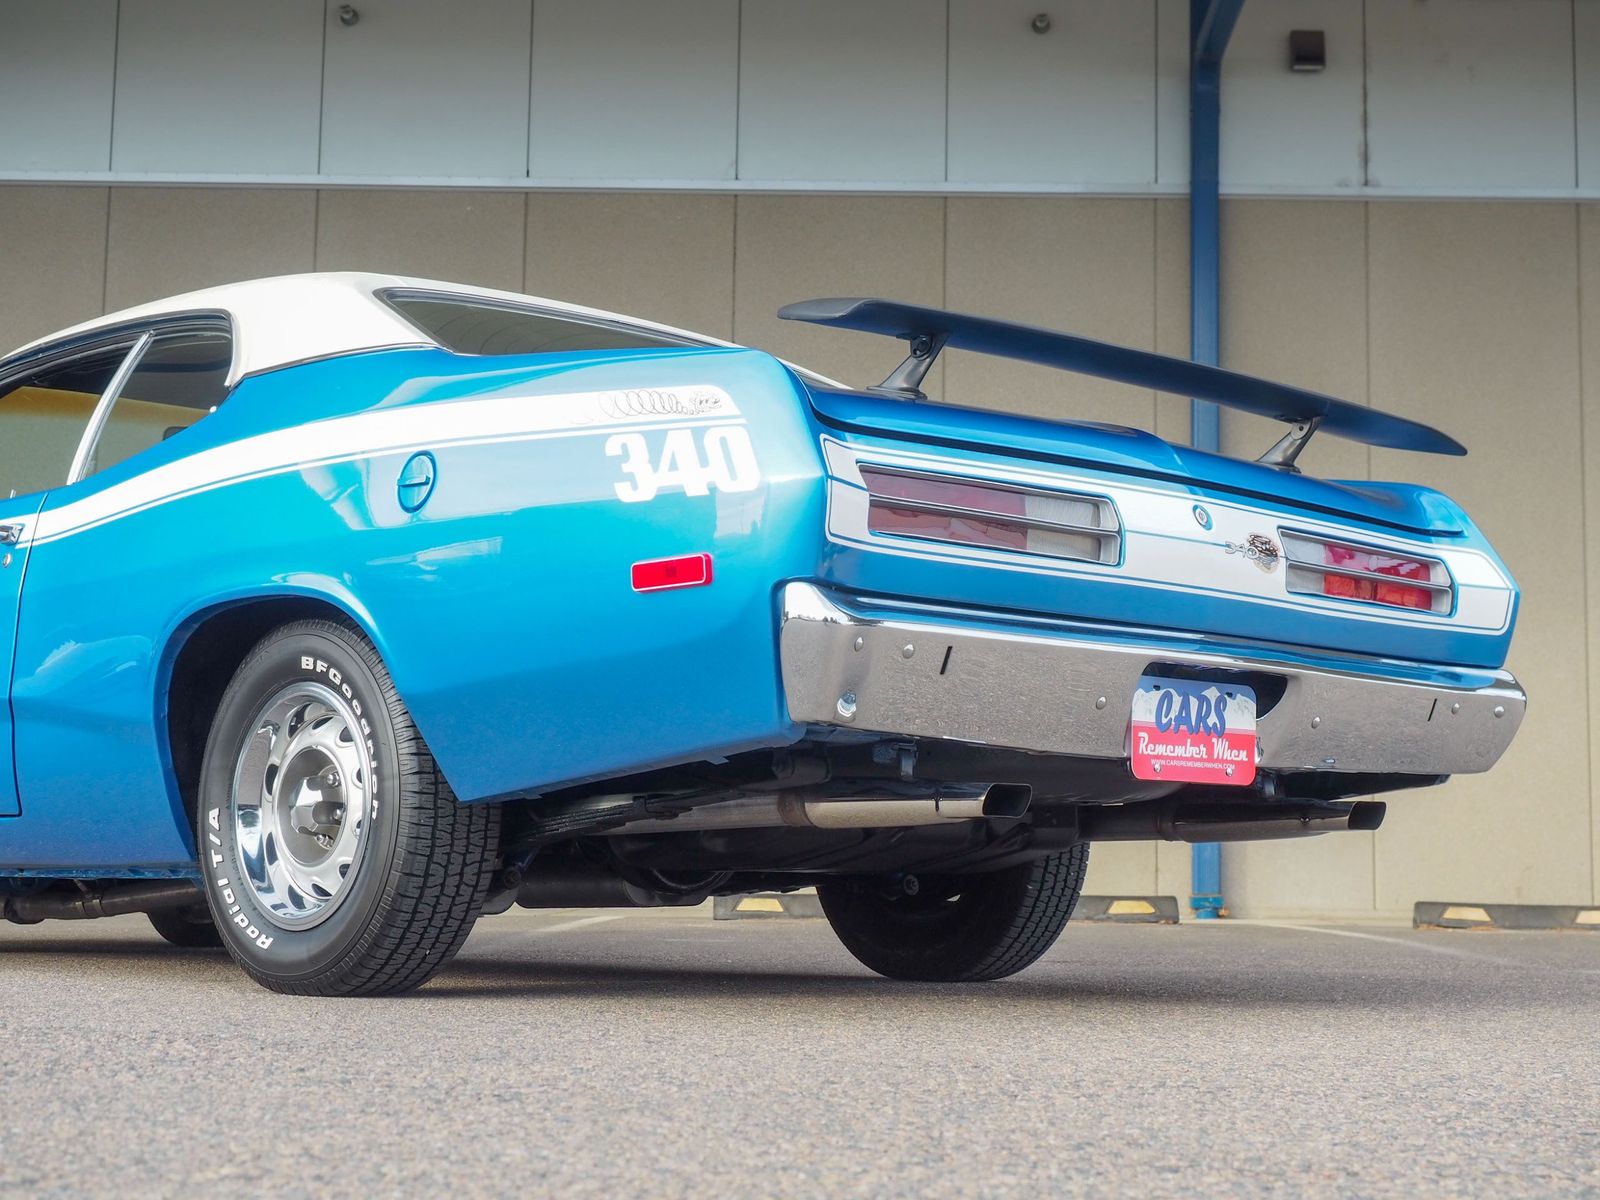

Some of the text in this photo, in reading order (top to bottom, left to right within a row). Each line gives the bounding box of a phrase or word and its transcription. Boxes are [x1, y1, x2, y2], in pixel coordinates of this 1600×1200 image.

[605, 426, 761, 502] 340
[301, 656, 379, 820] BFGoodrich
[1138, 732, 1248, 761] Remember When
[1155, 690, 1227, 737] CARS
[208, 807, 225, 870] T/A
[217, 878, 274, 950] Radial
